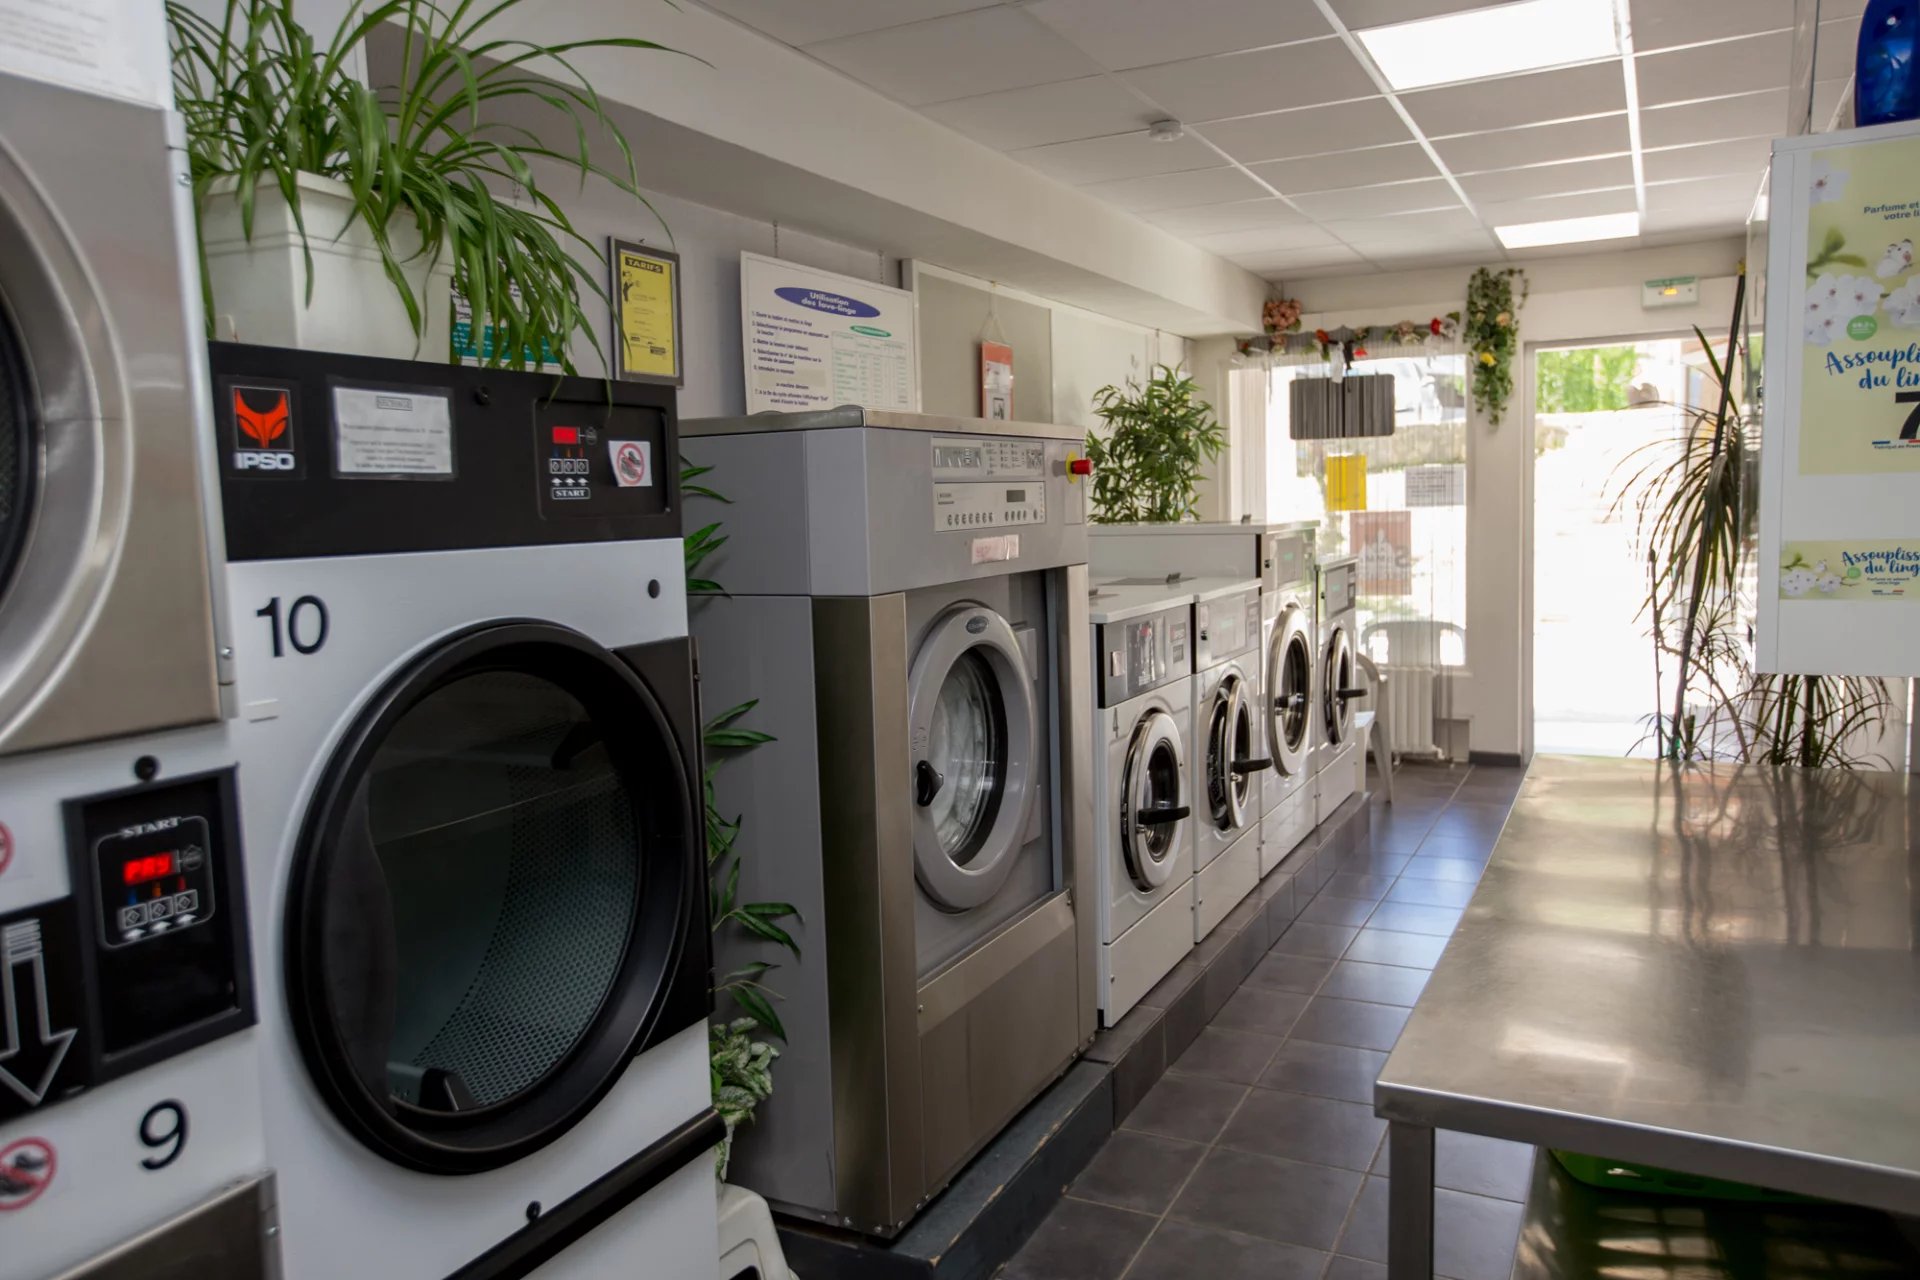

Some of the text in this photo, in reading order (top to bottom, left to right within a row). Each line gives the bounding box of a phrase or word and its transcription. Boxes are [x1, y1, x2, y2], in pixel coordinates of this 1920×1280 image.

[1864, 201, 1919, 214] Parfume et
[1884, 212, 1911, 220] votre
[628, 259, 661, 273] TARIFS
[802, 297, 857, 315] des lave-linge
[809, 291, 849, 306] Utilisation
[1858, 368, 1891, 389] du
[234, 452, 295, 470] IPSO
[1841, 547, 1920, 566] Assoupliss
[1864, 560, 1920, 577] du ling
[256, 595, 330, 658] 10
[120, 817, 182, 838] START
[139, 1098, 189, 1170] 9
